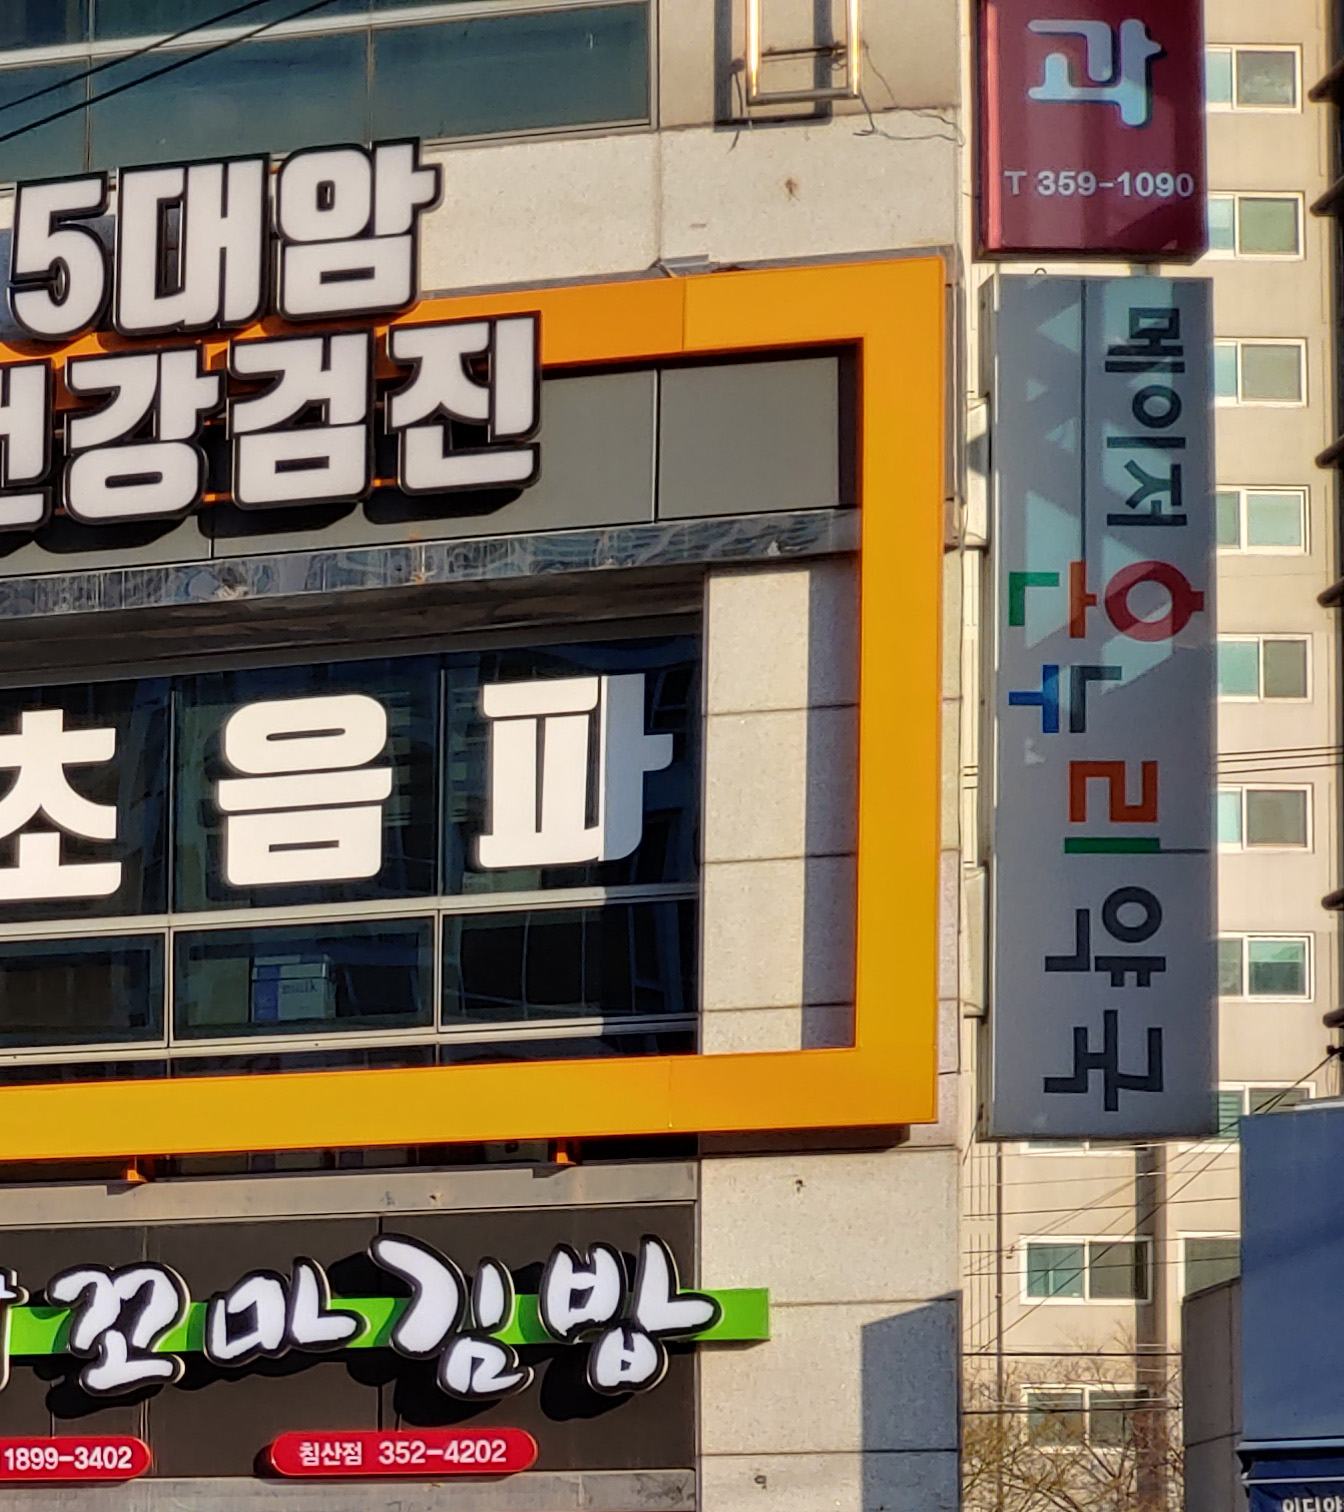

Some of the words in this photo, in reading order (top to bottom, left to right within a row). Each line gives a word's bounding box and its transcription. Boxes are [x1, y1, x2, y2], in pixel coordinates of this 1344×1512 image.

[1027, 19, 1162, 127] 과
[1037, 170, 1194, 197] 359-1090
[8, 137, 442, 340] 5대암
[1104, 306, 1188, 526] 메이저
[3, 1445, 133, 1472] 1899-3402
[298, 1440, 363, 1467] 침산점
[378, 1439, 507, 1466] 352-4202
